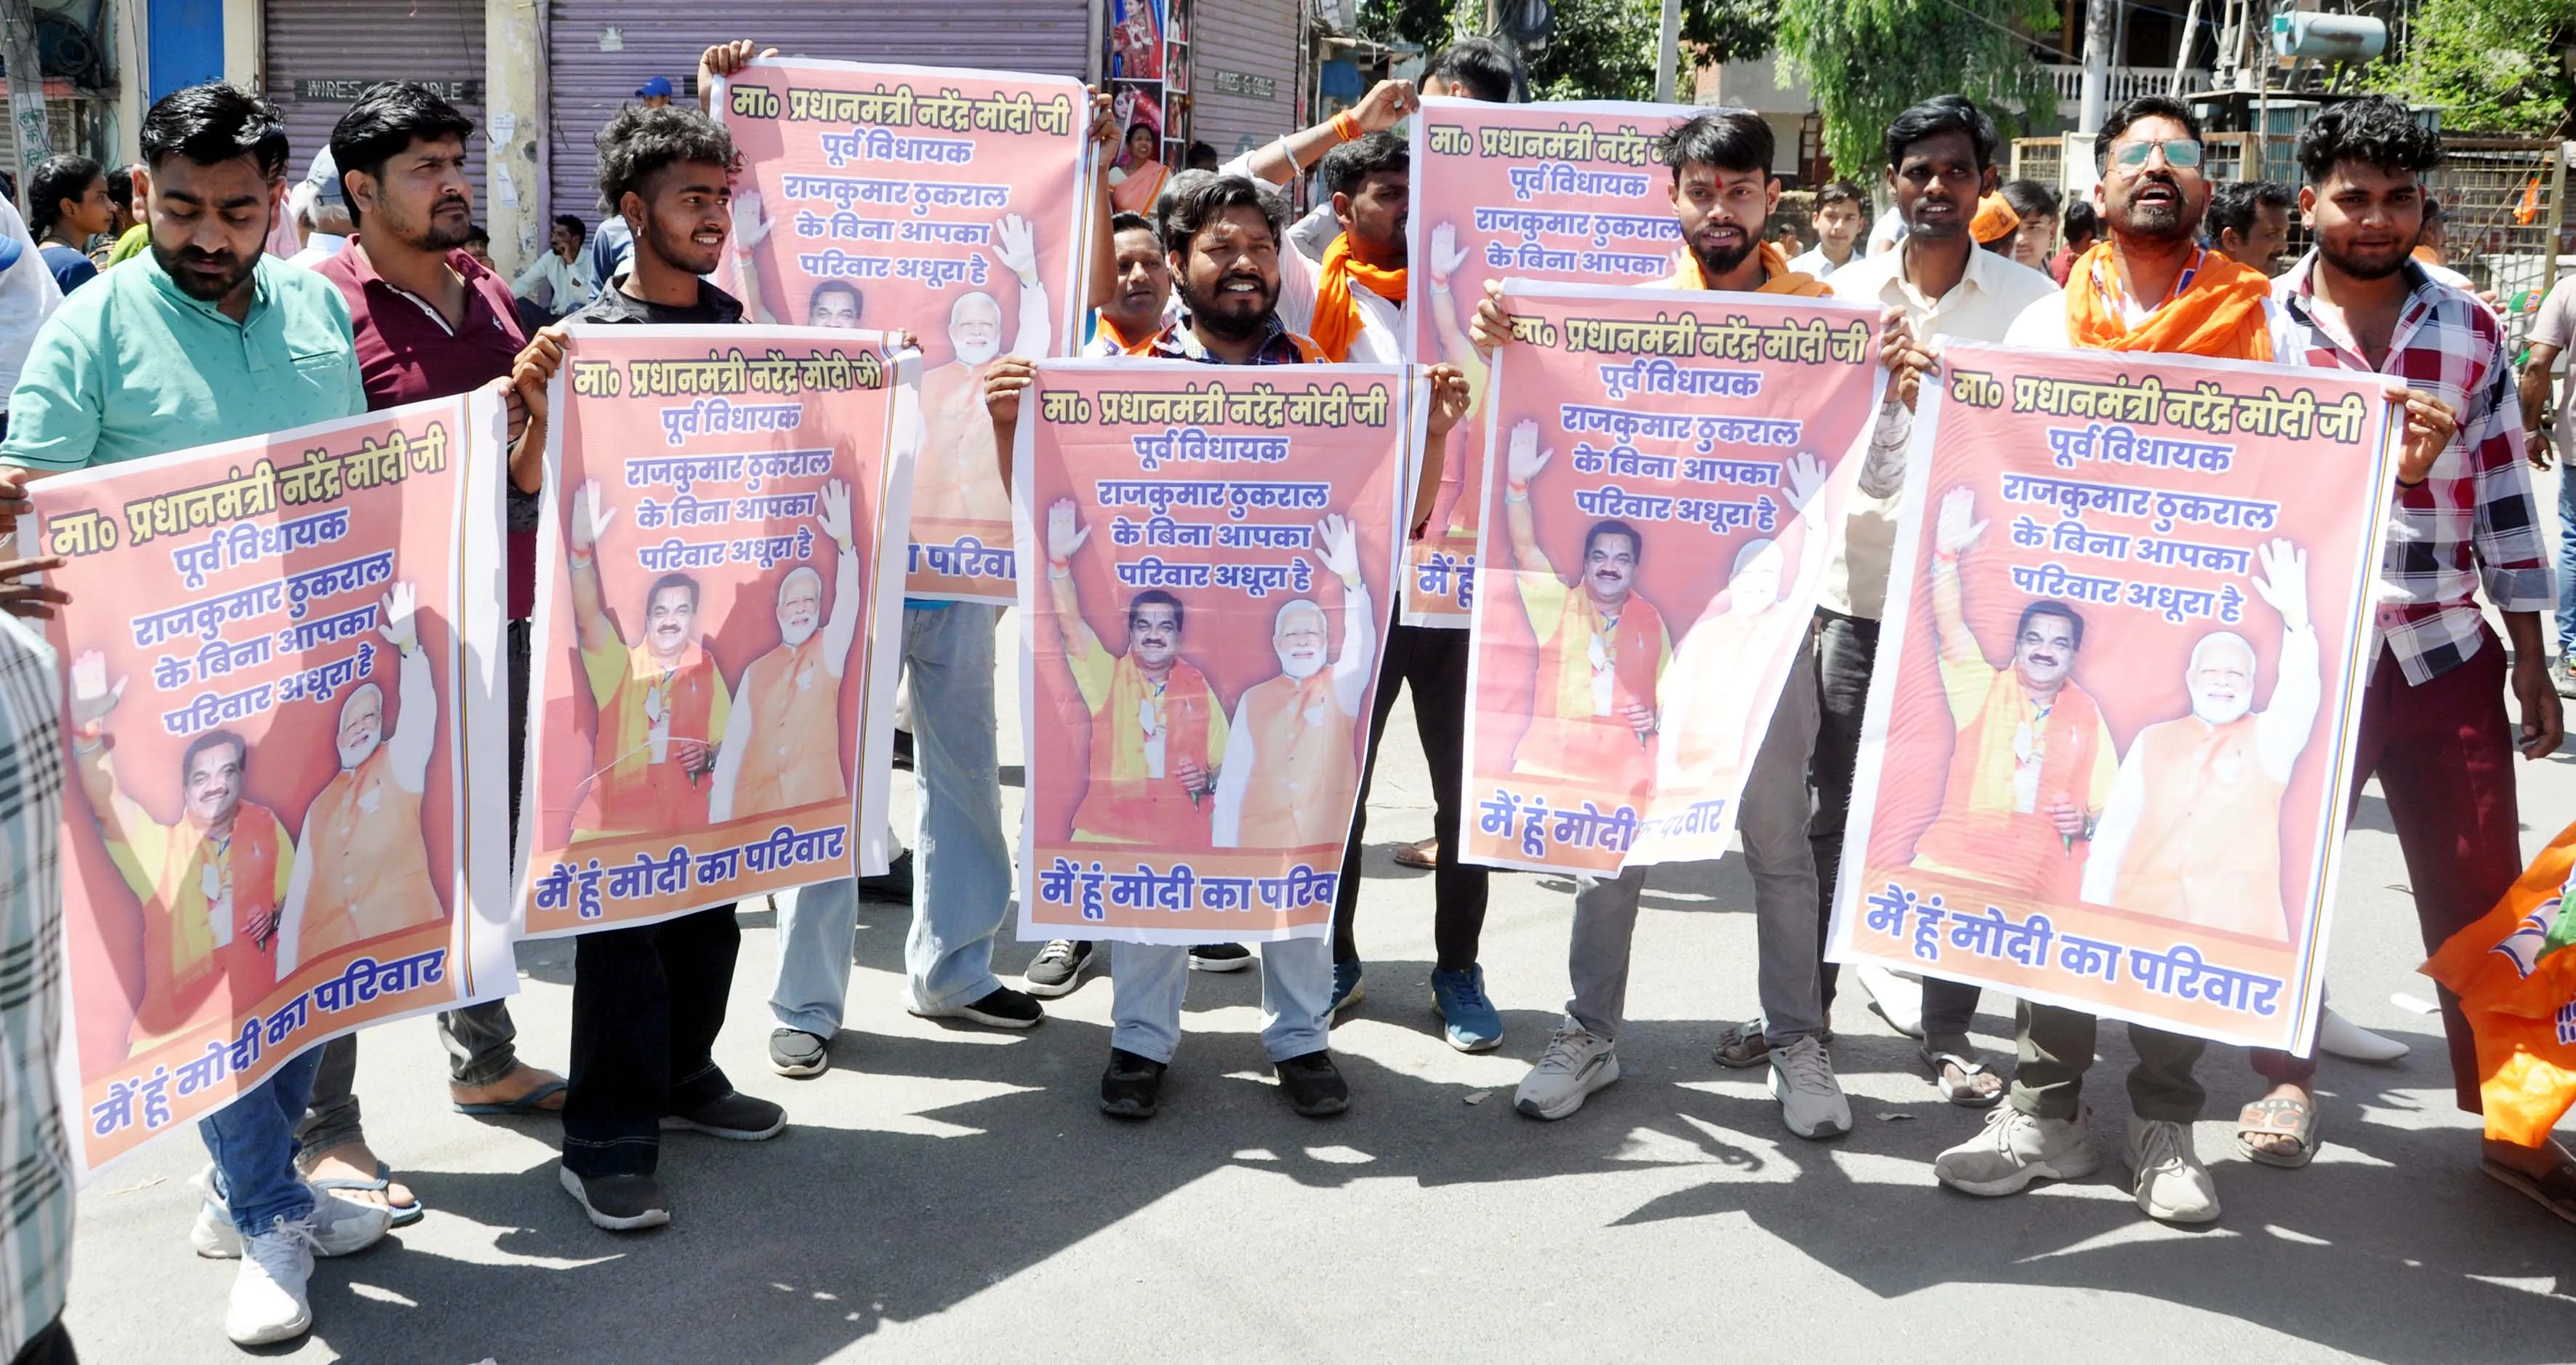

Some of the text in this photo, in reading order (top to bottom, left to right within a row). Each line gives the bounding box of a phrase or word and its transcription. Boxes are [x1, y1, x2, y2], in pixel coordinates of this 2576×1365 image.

[308, 80, 362, 97] WIRES
[731, 84, 1070, 136] मा० प्रधानमंत्री नरेंद्र मोदी जी
[821, 127, 974, 167] पूर्व विधायक
[1429, 124, 1472, 155] मा०
[1481, 121, 1595, 161] प्रधानमंत्री
[1597, 124, 1647, 167] नरेंद्र
[783, 175, 1010, 215] राजकुमार ठुकराल
[1509, 161, 1649, 200] पूर्व विधायक
[796, 212, 990, 246] के बिना आपका
[1475, 207, 1682, 247] राजकुमार ठुकराल
[799, 249, 989, 288] परिवार अधूरा है
[1487, 241, 1668, 276] के बिना आपका
[1509, 311, 1871, 365] मा० प्रधानमंत्री नरेंद्र मोदी जी
[572, 347, 882, 397] मा० प्रधानमंत्री नरेंद्र मोदी जी
[1600, 358, 1762, 401] पूर्व विधायक
[662, 399, 802, 447] पूर्व विधायक
[1043, 380, 1387, 427] मा० प्रधानमंत्री नरेंद्र मोदी जी
[1951, 370, 2366, 445] मा० प्रधानमंत्री नरेंद्र मोदी जी
[1133, 428, 1290, 469] पूर्व विधायक
[1561, 404, 1801, 452] राजकुमार ठुकराल
[2049, 424, 2233, 471] पूर्व विधायक
[49, 420, 446, 557] मा० प्रधानमंत्री नरेंद्र मोदी जी
[625, 449, 833, 492] राजकुमार ठुकराल
[1573, 444, 1781, 488] के बिना आपका
[637, 493, 816, 530] के बिना आपका
[1097, 480, 1331, 518] राजकुमार ठुकराल
[1575, 485, 1777, 535] परिवार अधूरा है
[2002, 473, 2278, 532] राजकुमार ठुकराल
[174, 507, 348, 589] पूर्व विधायक
[638, 527, 814, 570] परिवार अधूरा है
[1112, 517, 1311, 548] के बिना आपका
[2013, 518, 2251, 576] के बिना आपका
[926, 536, 1016, 579] परिवा
[1117, 557, 1311, 595] परिवार अधूरा है
[1417, 551, 1455, 596] मैं
[132, 550, 393, 648] राजकुमार ठुकराल
[2010, 564, 2244, 623] परिवार अधूरा है
[153, 604, 376, 692] के बिना आपका
[164, 644, 374, 737] परिवार अधूरा है
[1479, 789, 1522, 838] मैं
[1522, 796, 1547, 857] हूं
[1553, 802, 1637, 853] मोदी
[536, 825, 846, 919] मैं हूं मोदी का परिवार
[1039, 857, 1080, 905] मैं
[1080, 862, 1105, 921] हूं
[1110, 864, 1195, 911] मोदी
[1200, 877, 1253, 910] का
[1866, 884, 2284, 1016] मैं हूं मोदी का परिवार
[92, 948, 446, 1138] मैं हूं मोदी का परिवार
[2242, 1108, 2302, 1132] BIG
